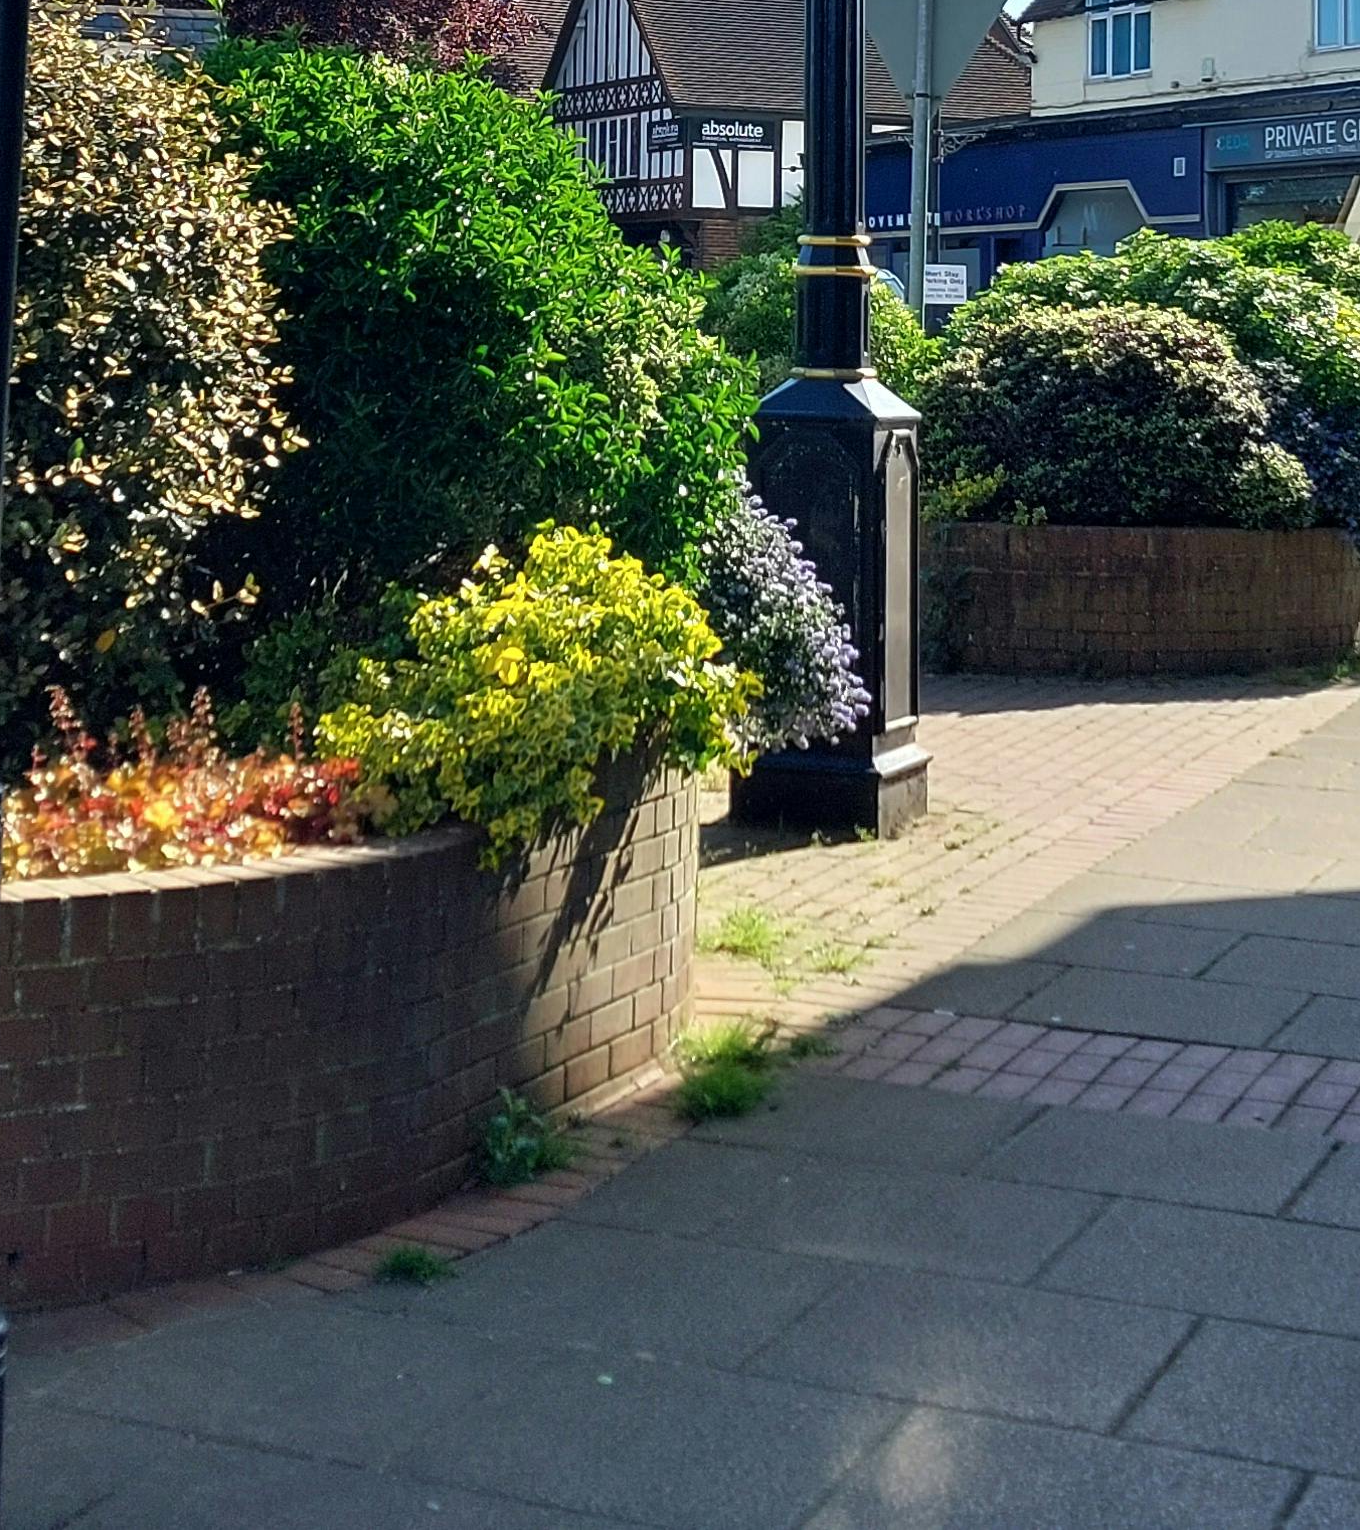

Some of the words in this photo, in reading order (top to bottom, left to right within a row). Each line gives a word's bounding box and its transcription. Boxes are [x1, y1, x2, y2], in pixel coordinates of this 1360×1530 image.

[702, 119, 764, 137] absolute
[1264, 120, 1337, 149] PRIVATE
[943, 205, 1026, 222] WORKSHOP
